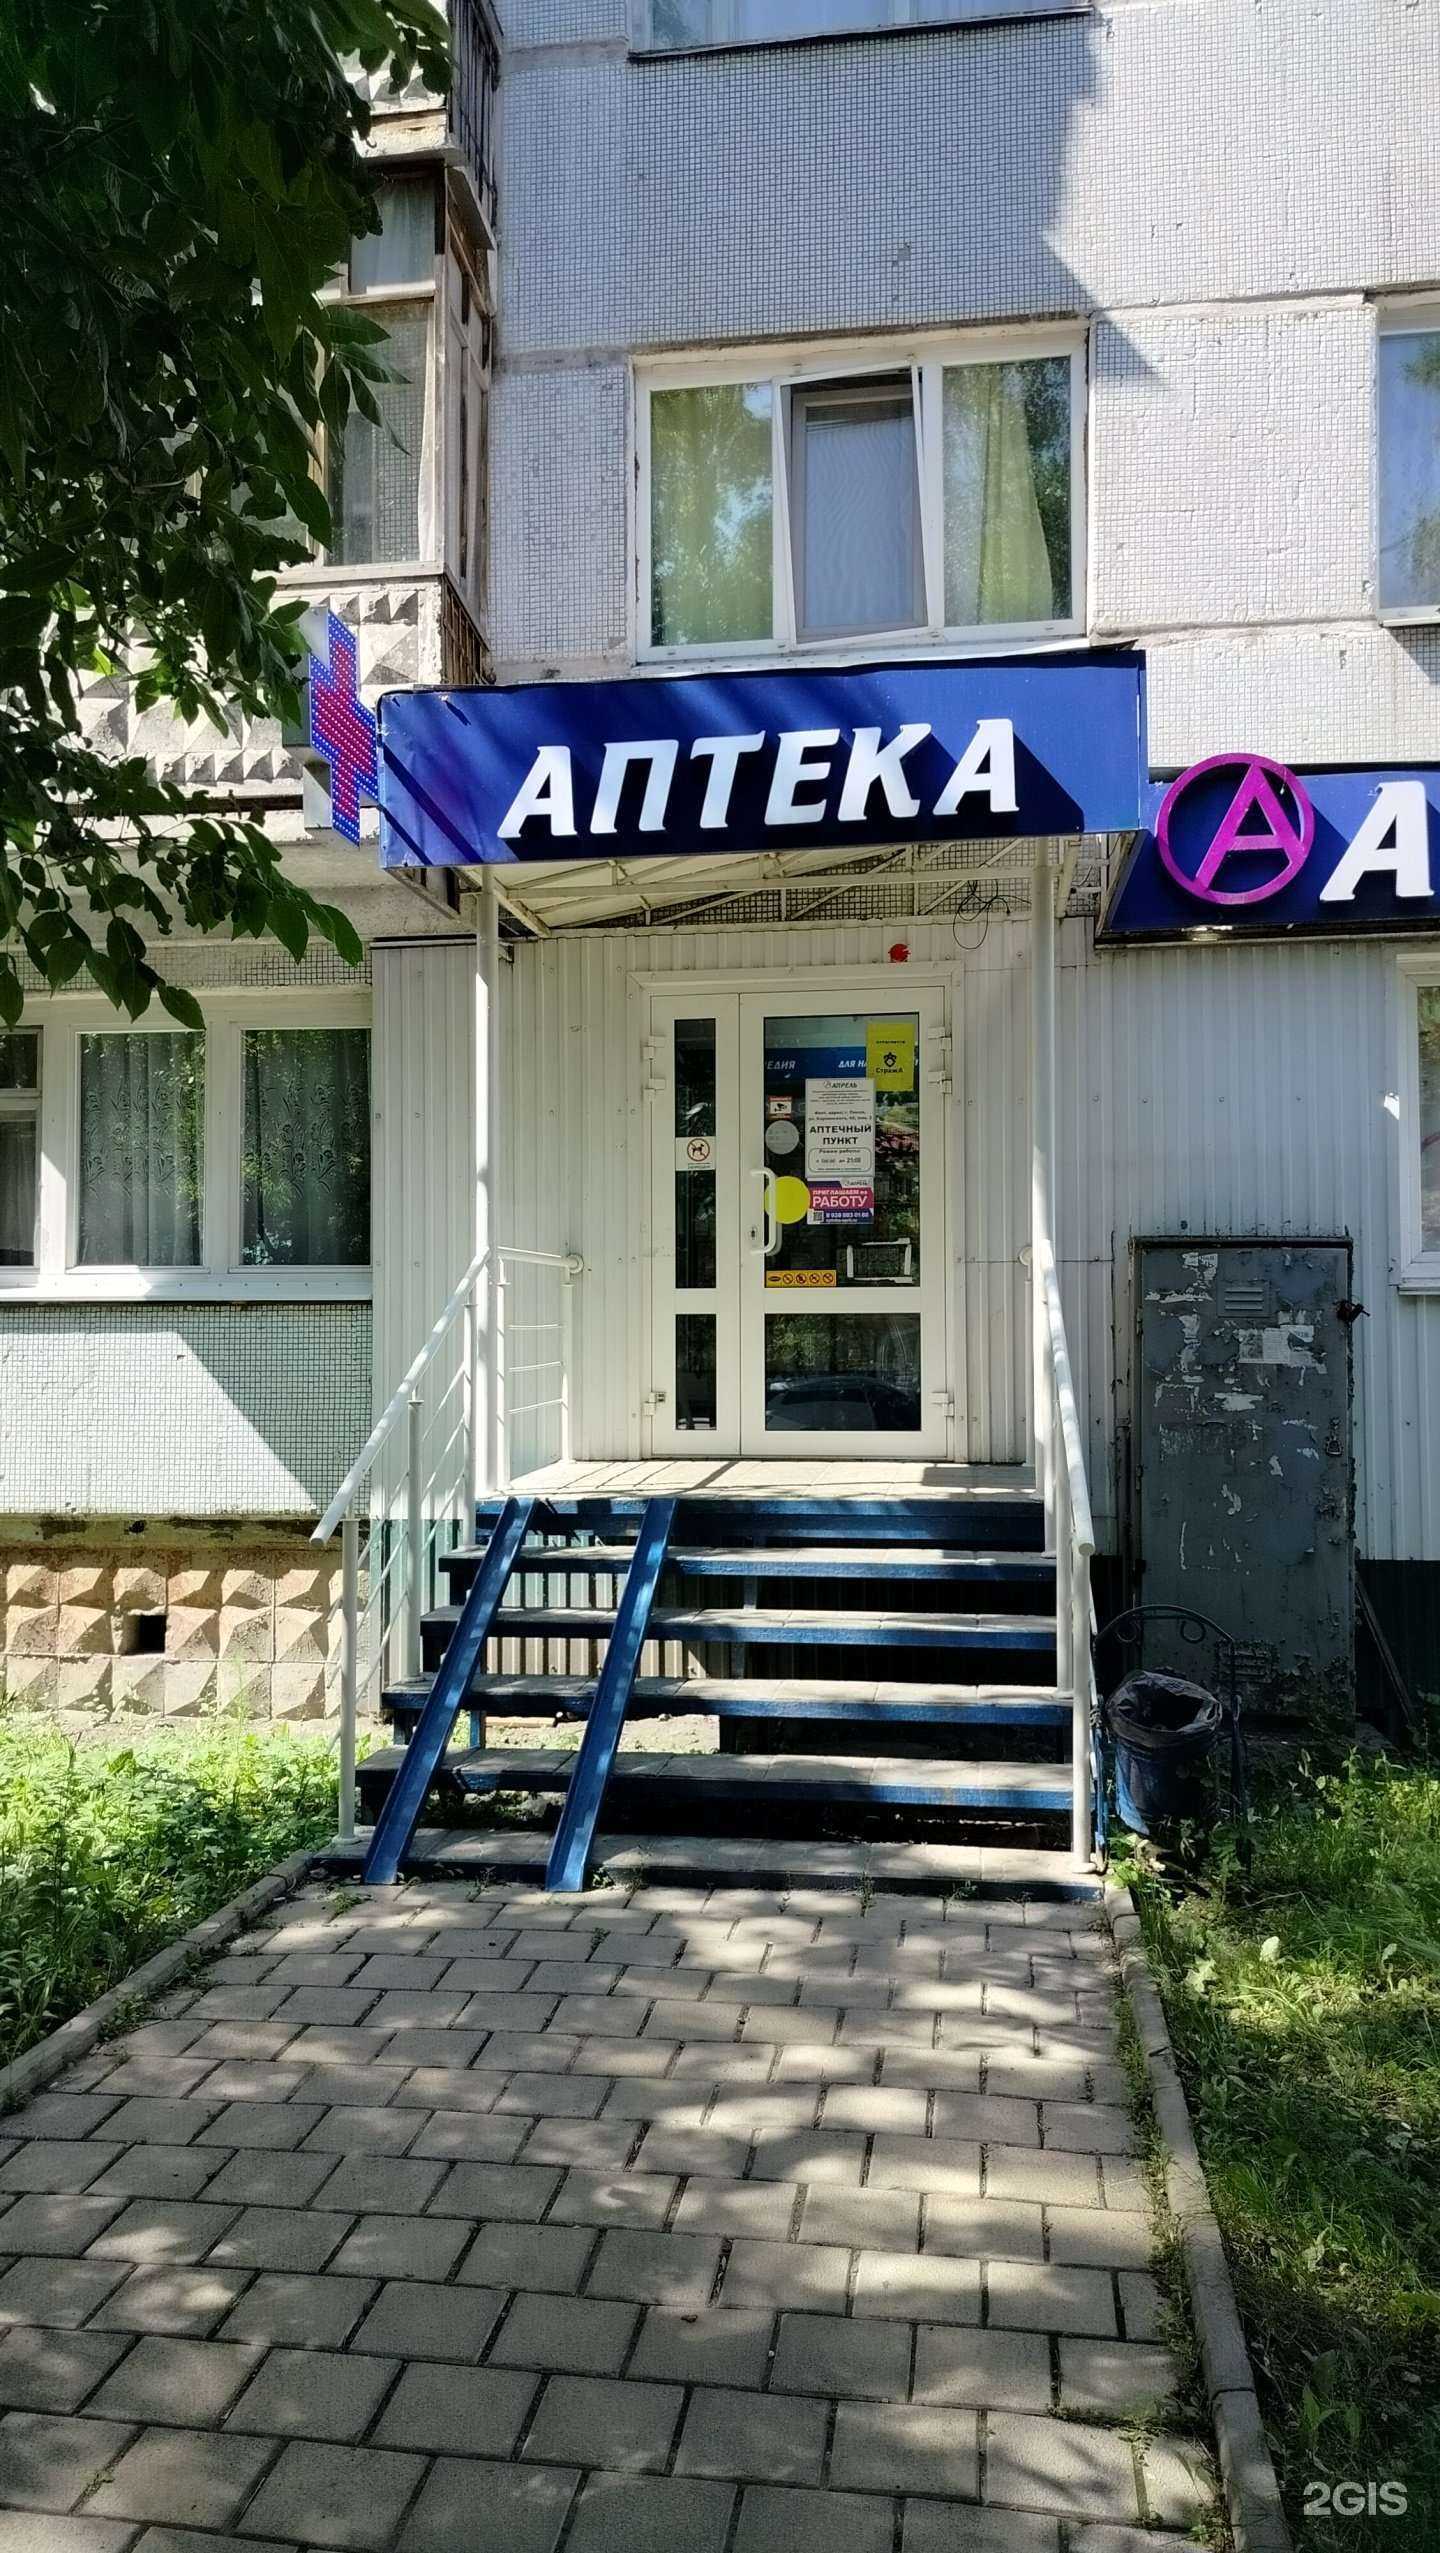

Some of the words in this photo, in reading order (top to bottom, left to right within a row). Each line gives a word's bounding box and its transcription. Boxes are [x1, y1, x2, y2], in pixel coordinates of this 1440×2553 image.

[498, 718, 1020, 839] АПТЕКА
[1319, 780, 1434, 901] А
[765, 1060, 796, 1070] ЕДИЯ
[810, 1124, 872, 1134] АПТЕЧНЫЙ
[823, 1137, 859, 1145] ПУНКТ
[812, 1196, 868, 1207] РАБОТУ
